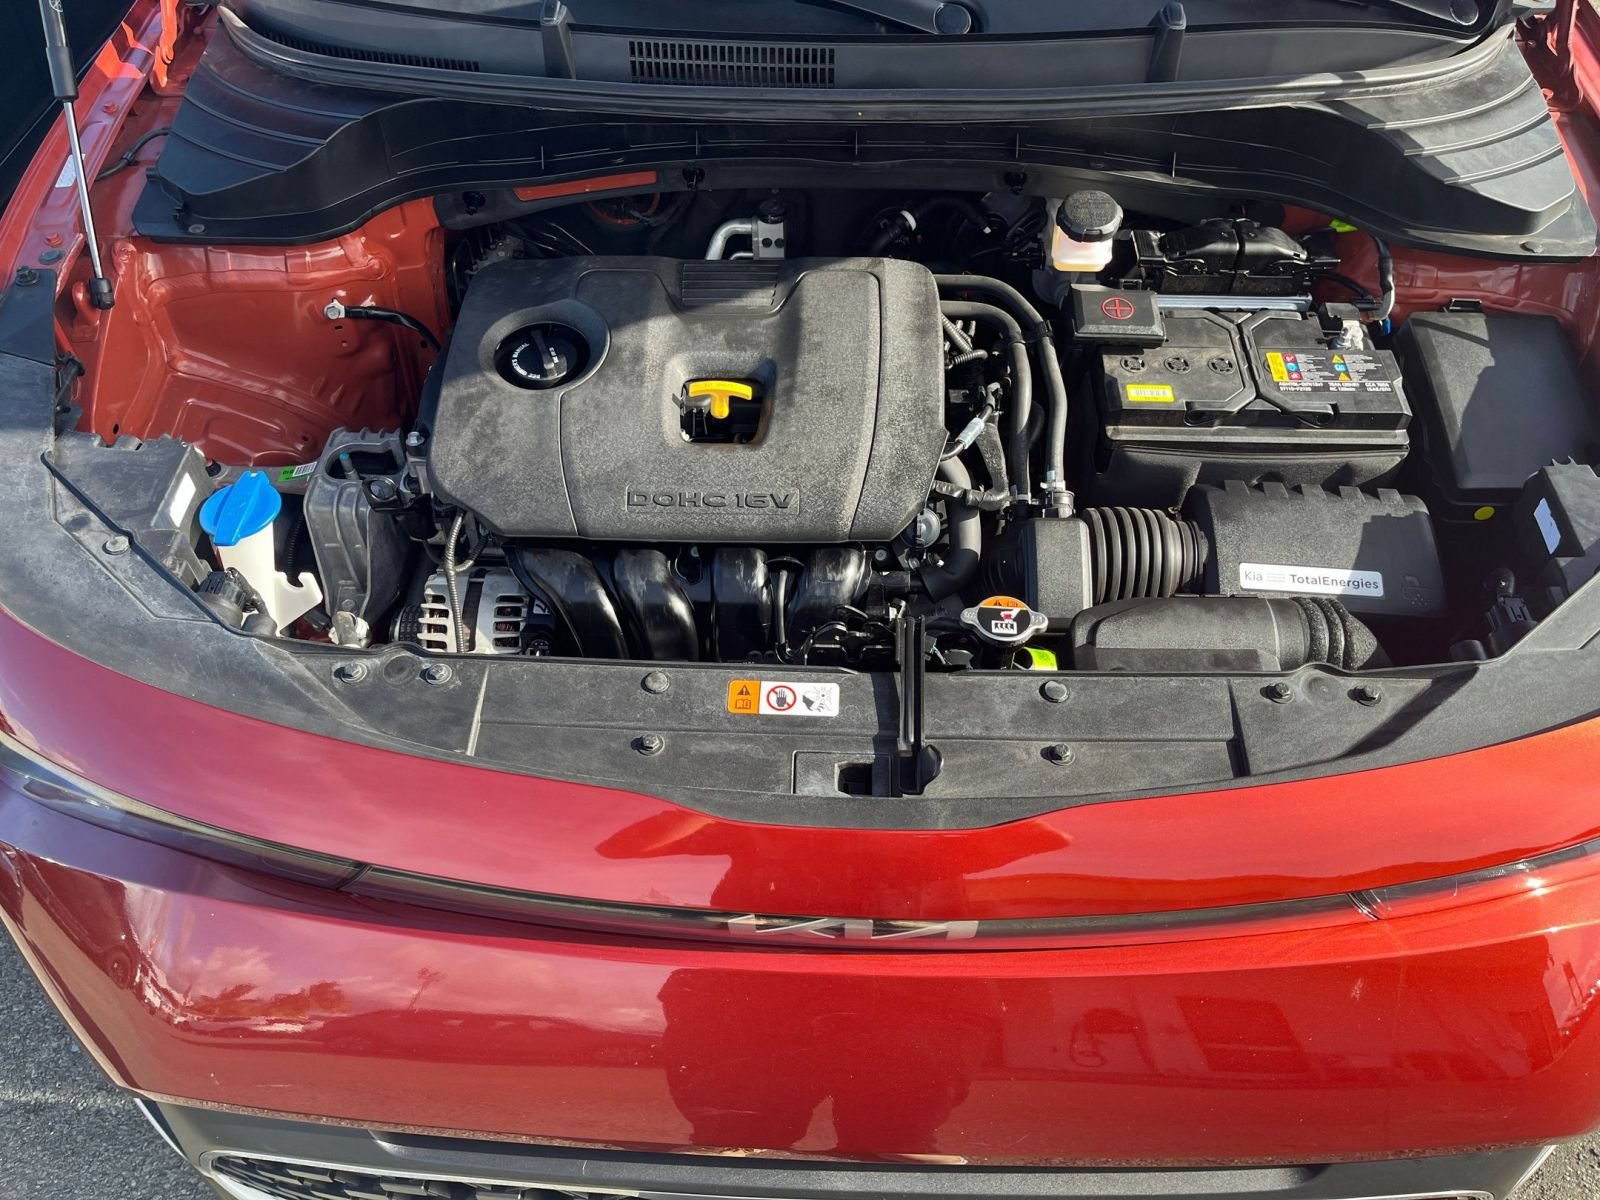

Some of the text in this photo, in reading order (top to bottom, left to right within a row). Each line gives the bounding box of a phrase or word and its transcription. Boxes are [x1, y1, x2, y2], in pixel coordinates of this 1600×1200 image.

[626, 491, 792, 509] DOHC 16V
[1244, 570, 1379, 590] Kia TotalEnergies
